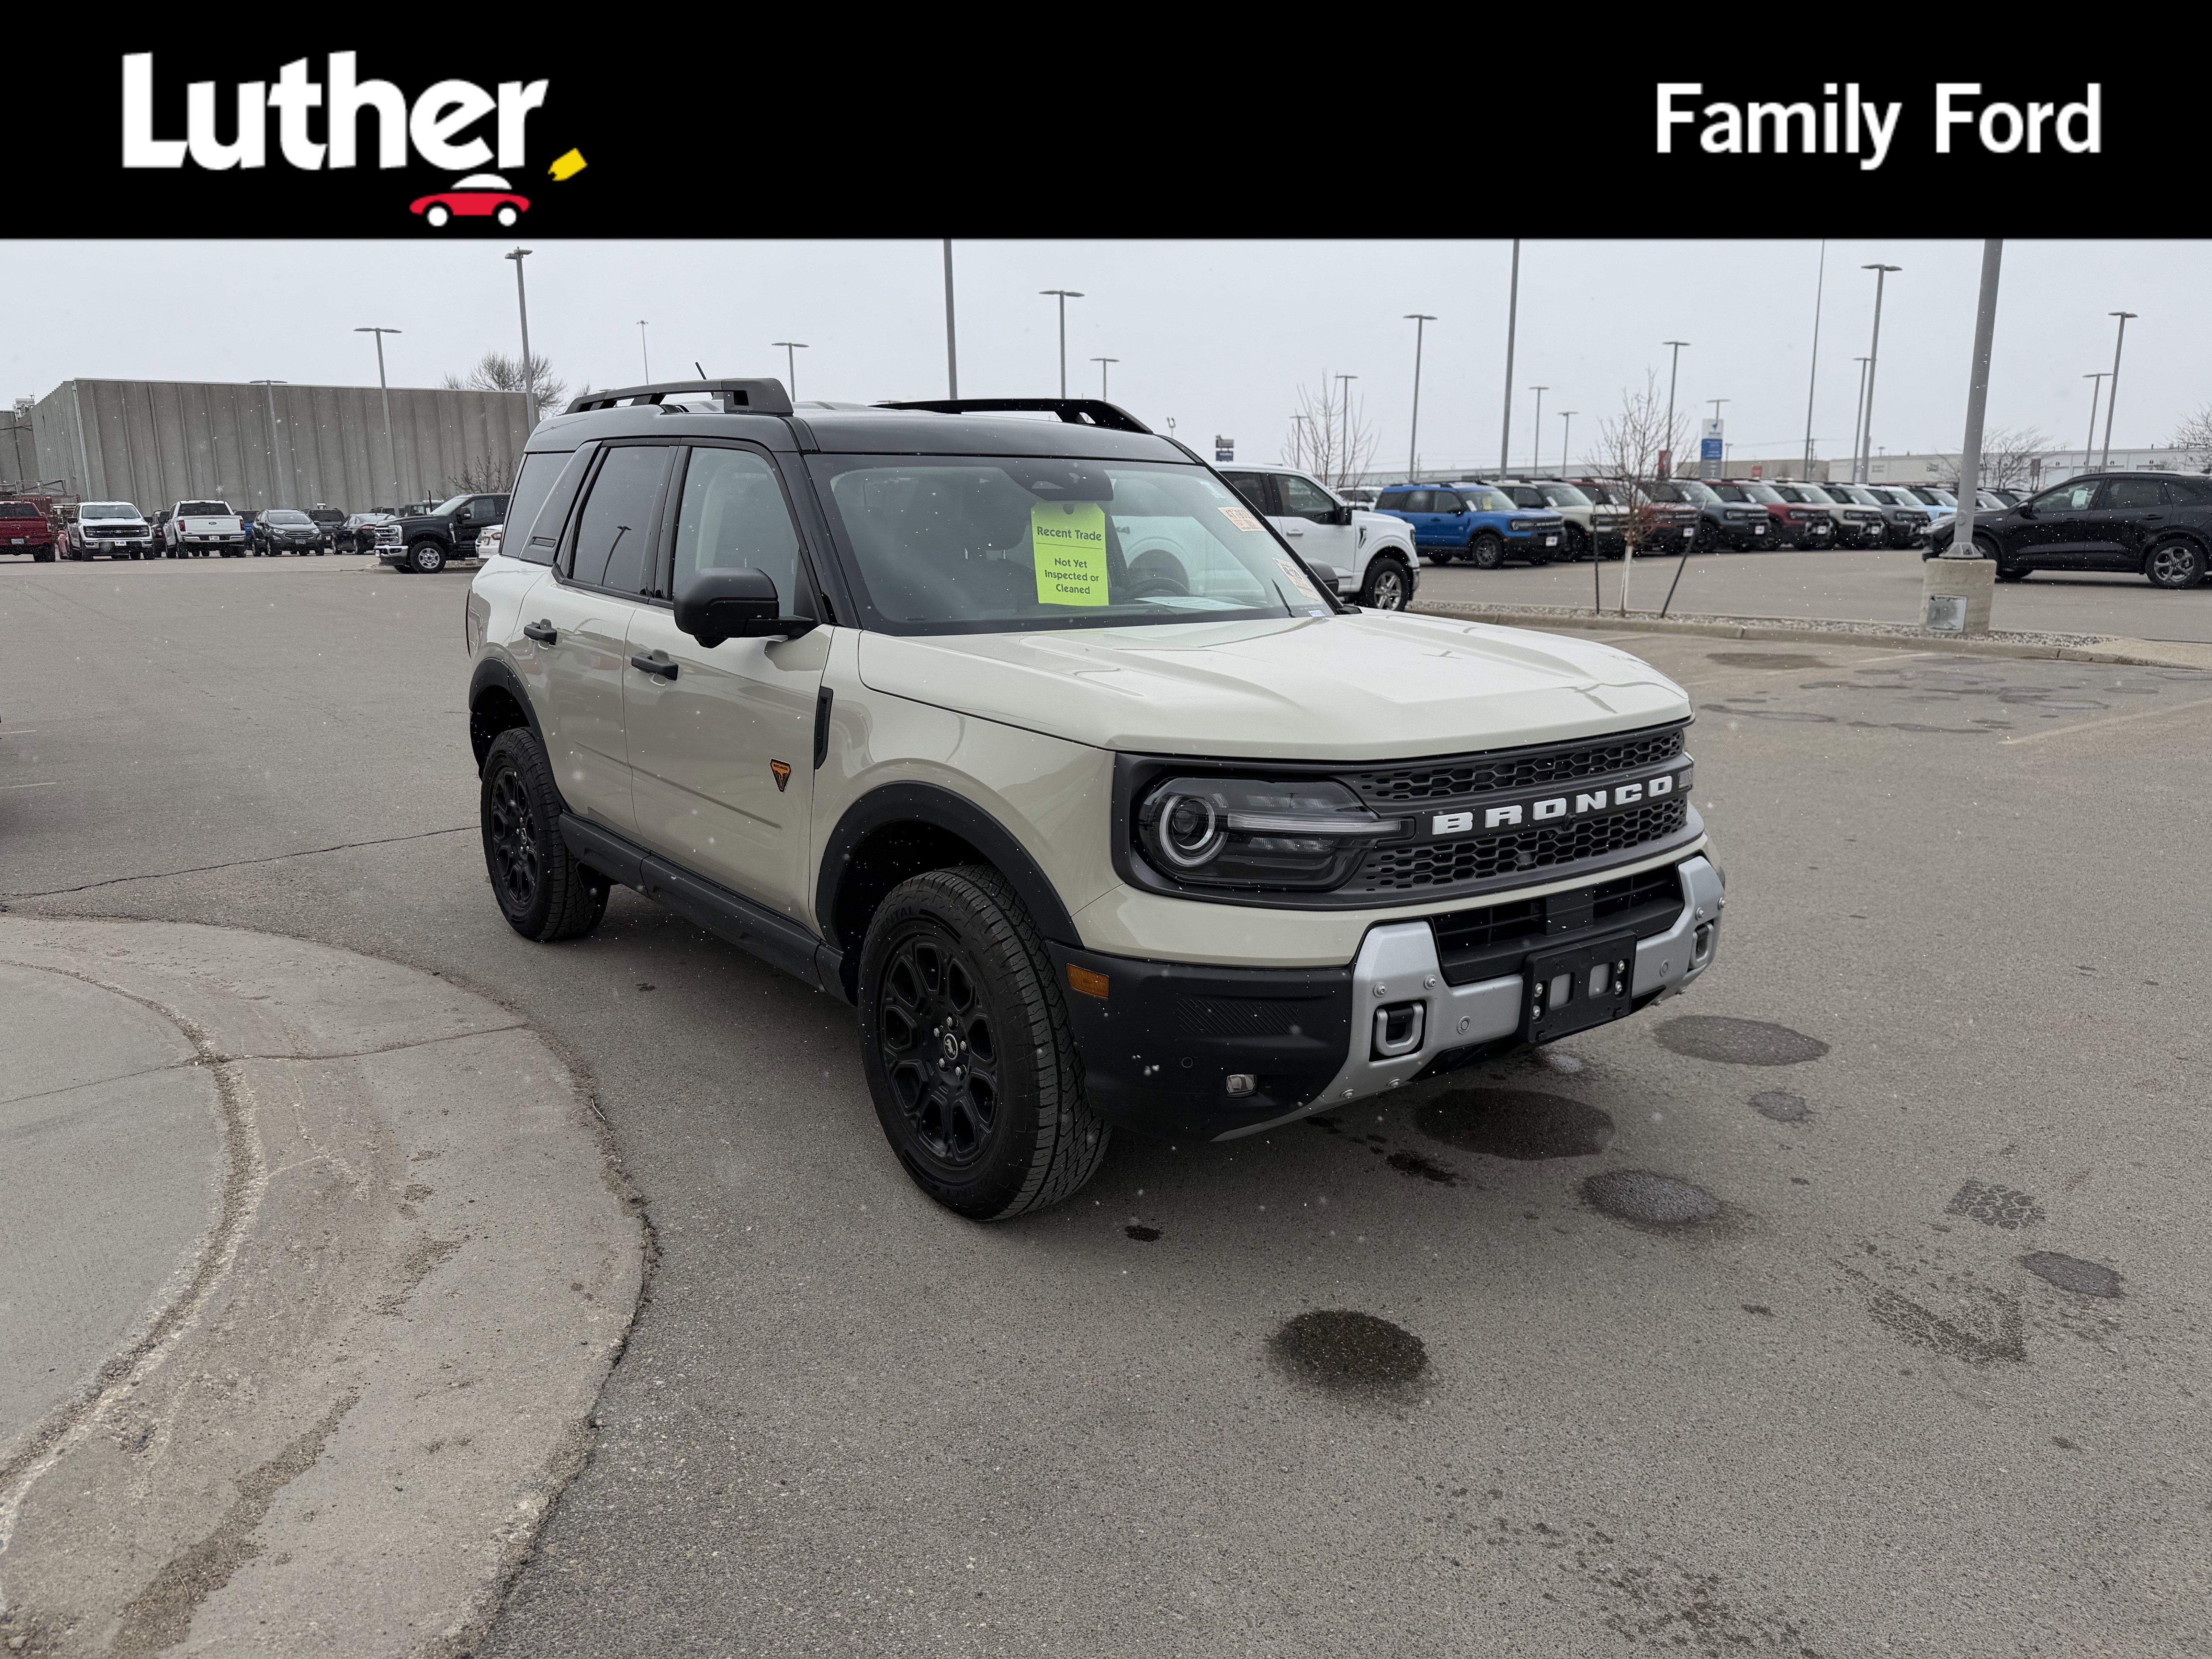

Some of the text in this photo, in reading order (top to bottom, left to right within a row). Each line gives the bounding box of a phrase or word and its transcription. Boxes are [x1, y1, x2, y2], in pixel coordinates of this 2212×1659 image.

[1037, 526, 1102, 541] Recent Trade
[1054, 558, 1087, 568] Not Yet
[1044, 569, 1087, 581] Inspected
[1055, 584, 1090, 594] Cleaned
[1431, 775, 1673, 835] BRONCO
